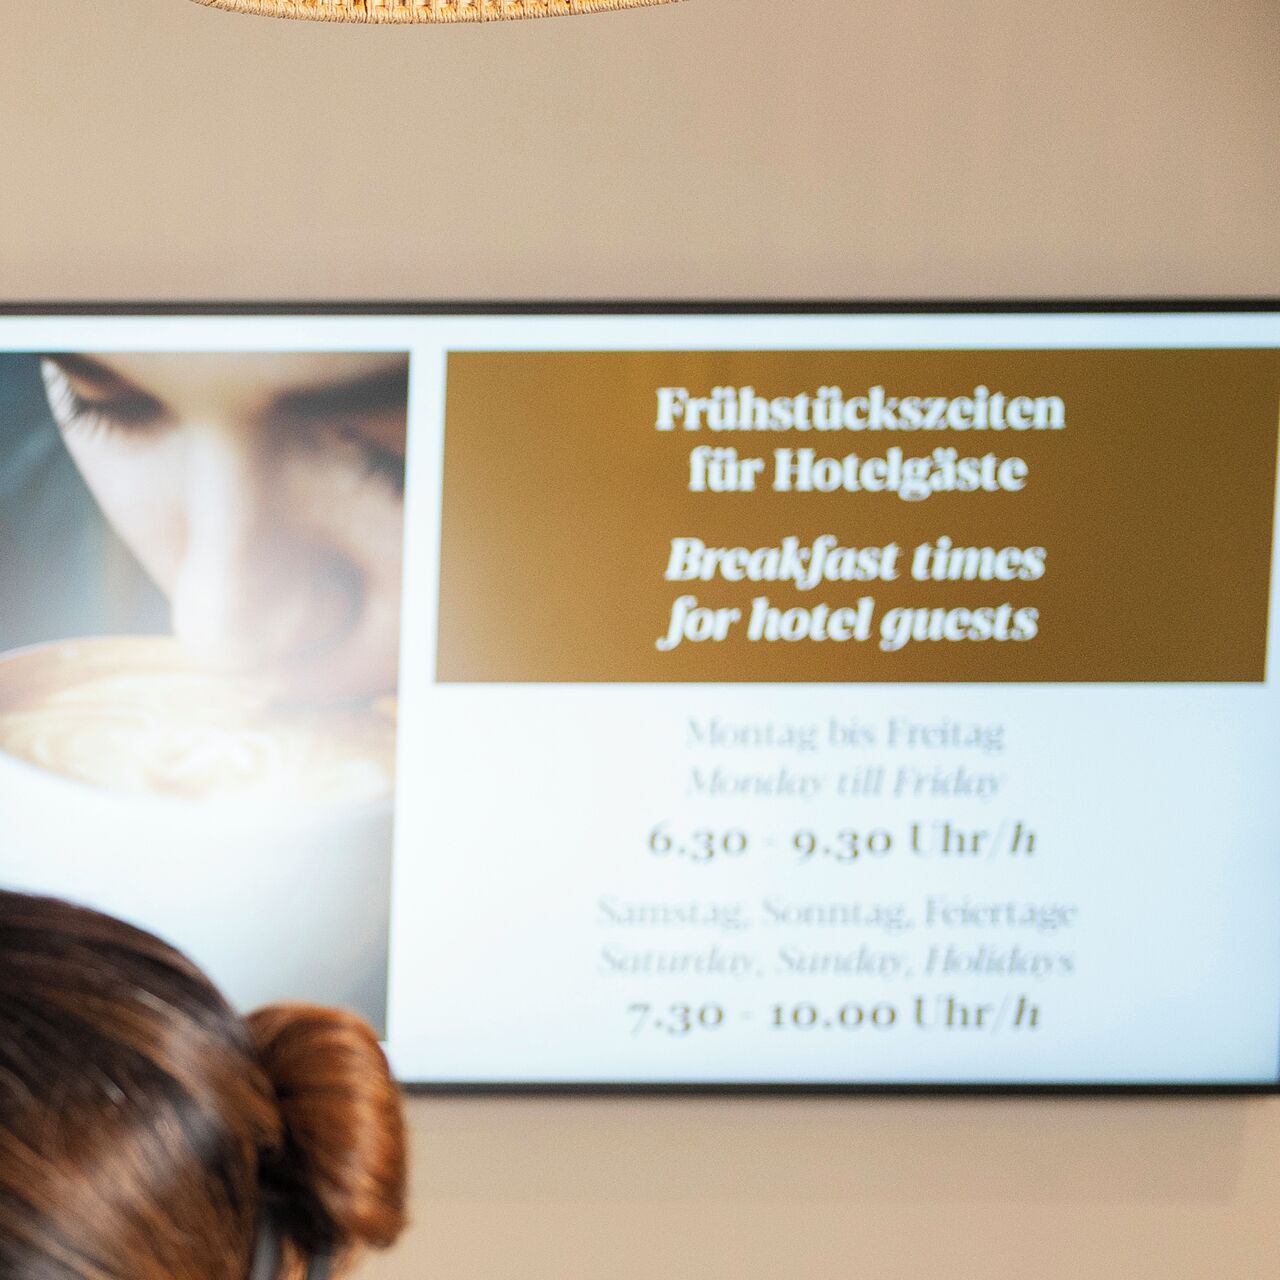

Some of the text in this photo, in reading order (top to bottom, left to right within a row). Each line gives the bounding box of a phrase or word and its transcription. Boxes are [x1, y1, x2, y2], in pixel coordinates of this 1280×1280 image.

[655, 385, 1066, 431] Frühstückszeiten
[688, 445, 1029, 501] für Hotelgäste
[664, 534, 1047, 590] Breakfast times
[655, 594, 1039, 652] for hotel guests
[687, 717, 1006, 753] Montag bis Freitag
[685, 766, 1002, 799] Monday till Friday
[647, 819, 748, 862] 6.30
[791, 826, 893, 862] 9.30
[908, 820, 1038, 862] Uhr/h
[596, 897, 1079, 932] Samstag, Sonntag, Feiertage
[598, 945, 1075, 978] Saturday, Sunday, Holidays
[626, 1000, 724, 1036] 7.30
[769, 1002, 898, 1032] 10.00
[912, 995, 1040, 1034] Uhr/h
